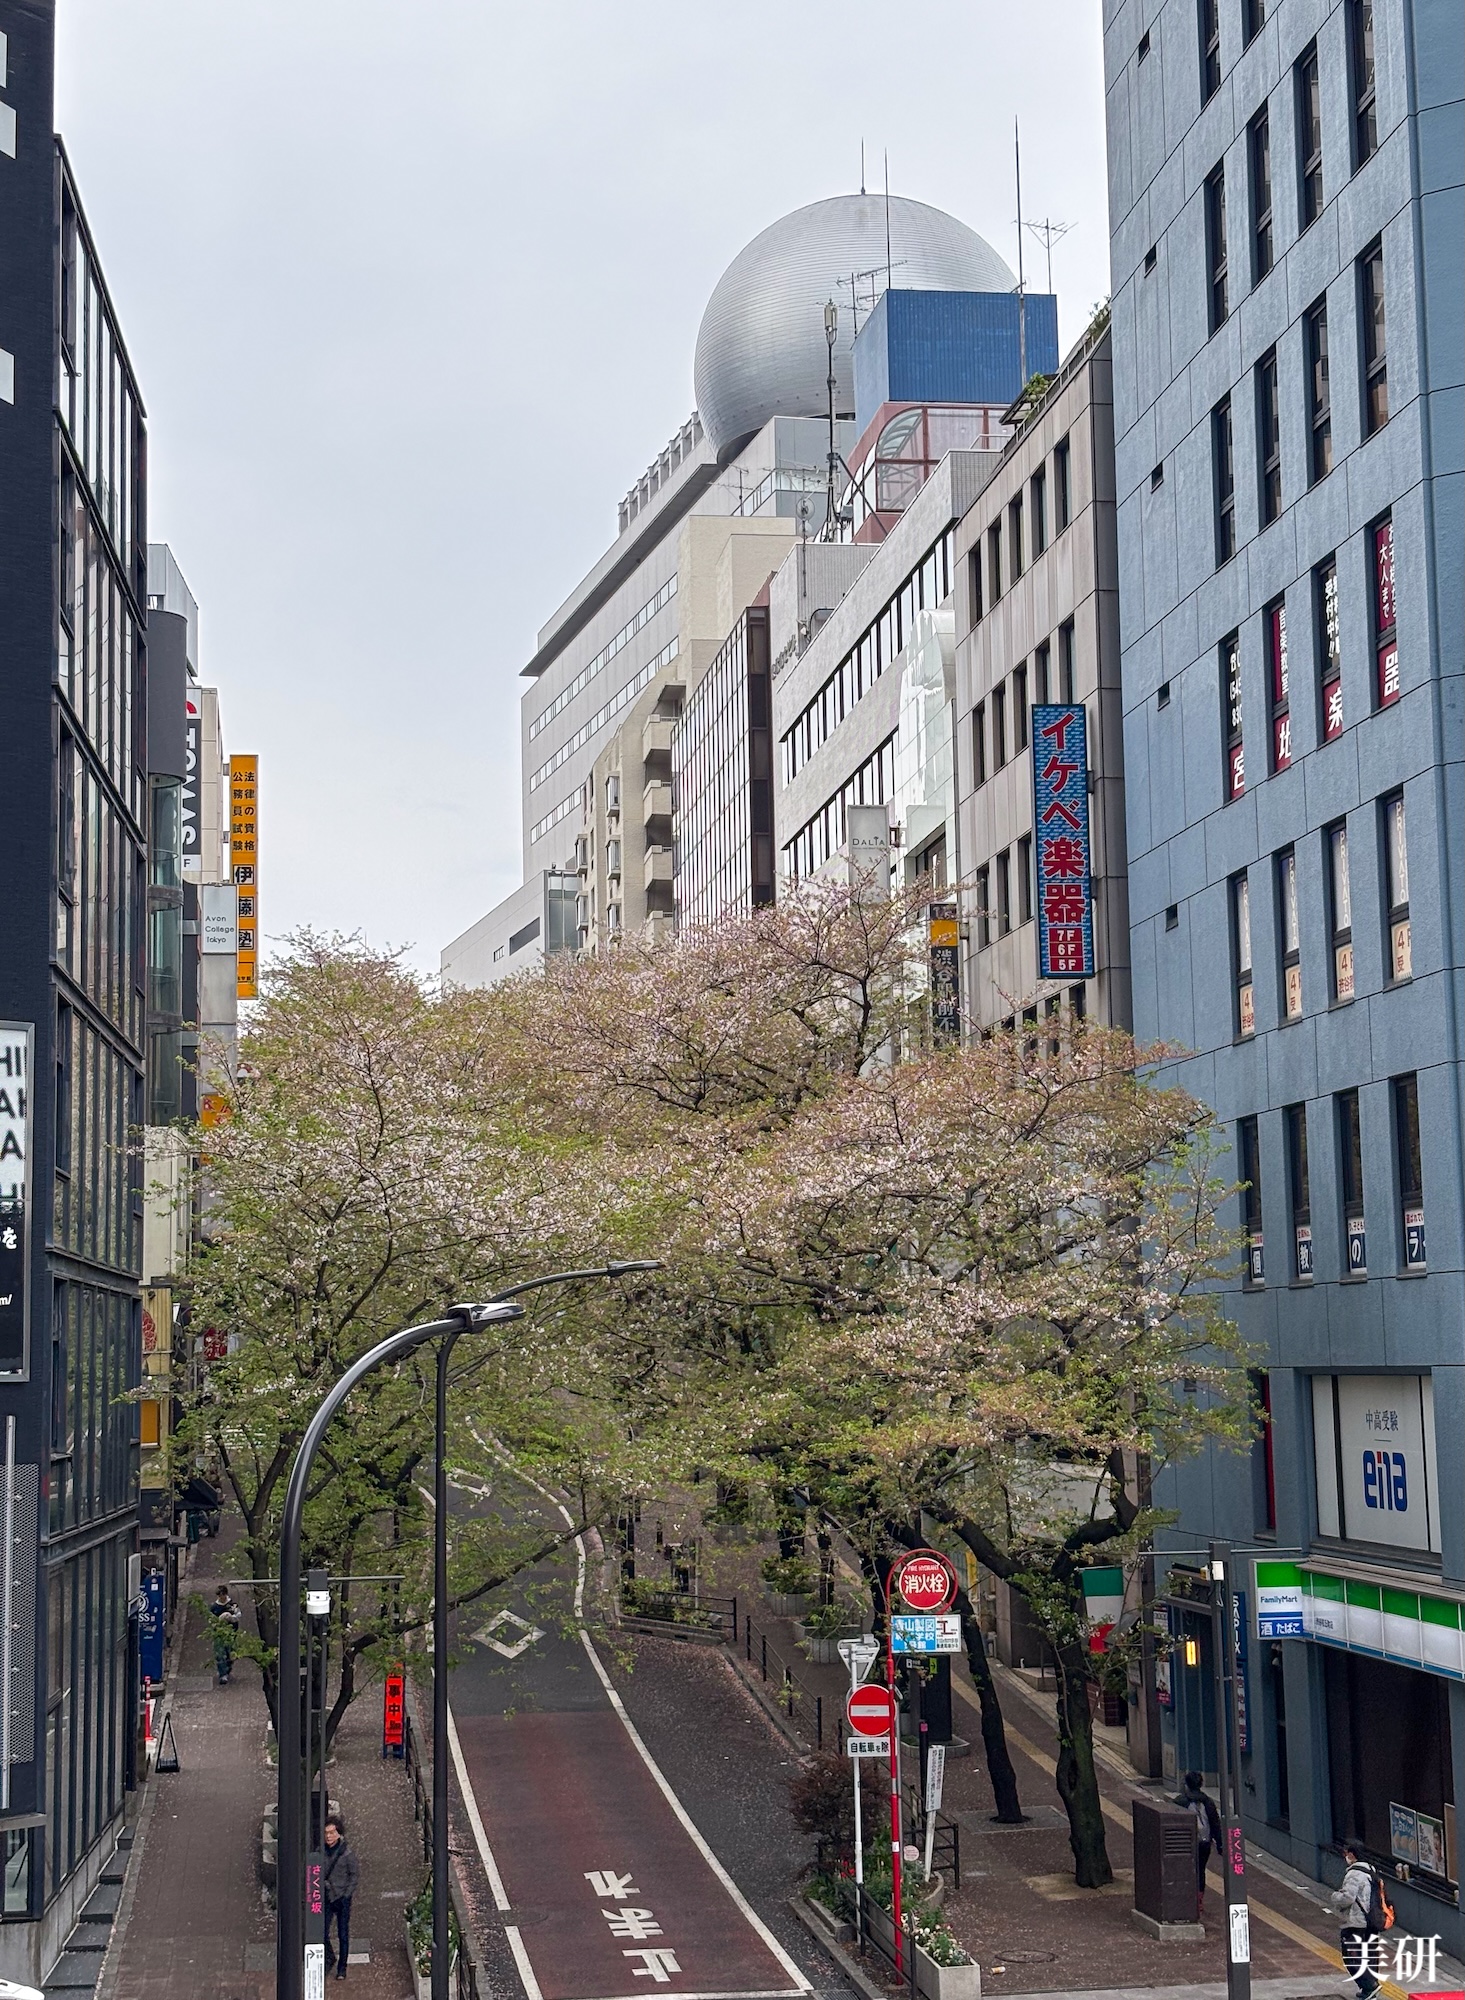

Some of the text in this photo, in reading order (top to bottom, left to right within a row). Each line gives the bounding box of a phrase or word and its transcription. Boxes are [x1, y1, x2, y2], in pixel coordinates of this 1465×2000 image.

[1379, 543, 1389, 619] 大人まで
[232, 771, 243, 851] 公務員試験
[244, 771, 255, 851] 法律の資格
[1041, 713, 1087, 925] イケベ楽器
[852, 836, 885, 846] DALIA
[1396, 801, 1406, 902] PRIVATO
[1339, 830, 1349, 927] PRIVATO
[234, 866, 254, 948] 伊藤塾
[1288, 857, 1299, 948] PRIVATO
[205, 925, 235, 934] College
[206, 936, 227, 944] Tokyo
[1056, 929, 1075, 942] 7F
[1057, 944, 1076, 956] 6F
[1058, 958, 1076, 971] 5F
[1290, 973, 1301, 992] 4
[1299, 1244, 1310, 1270] 教
[1351, 1239, 1361, 1263] の
[1408, 1231, 1419, 1258] ラ
[1365, 1409, 1399, 1432] 中高受験
[1362, 1450, 1409, 1512] ena
[903, 1573, 945, 1594] 消火栓
[1260, 1595, 1298, 1605] FamilyMart
[895, 1632, 935, 1642] 専学校
[1232, 1595, 1242, 1654] SAPIX
[1260, 1621, 1274, 1637] 酒
[1276, 1621, 1301, 1635] たばこ
[388, 1671, 401, 1716] 事中
[850, 1741, 890, 1753] 自転車を除
[1233, 1827, 1245, 1876] さくら坂
[311, 1864, 323, 1914] さくら坂
[583, 1870, 682, 1983] 止まれ
